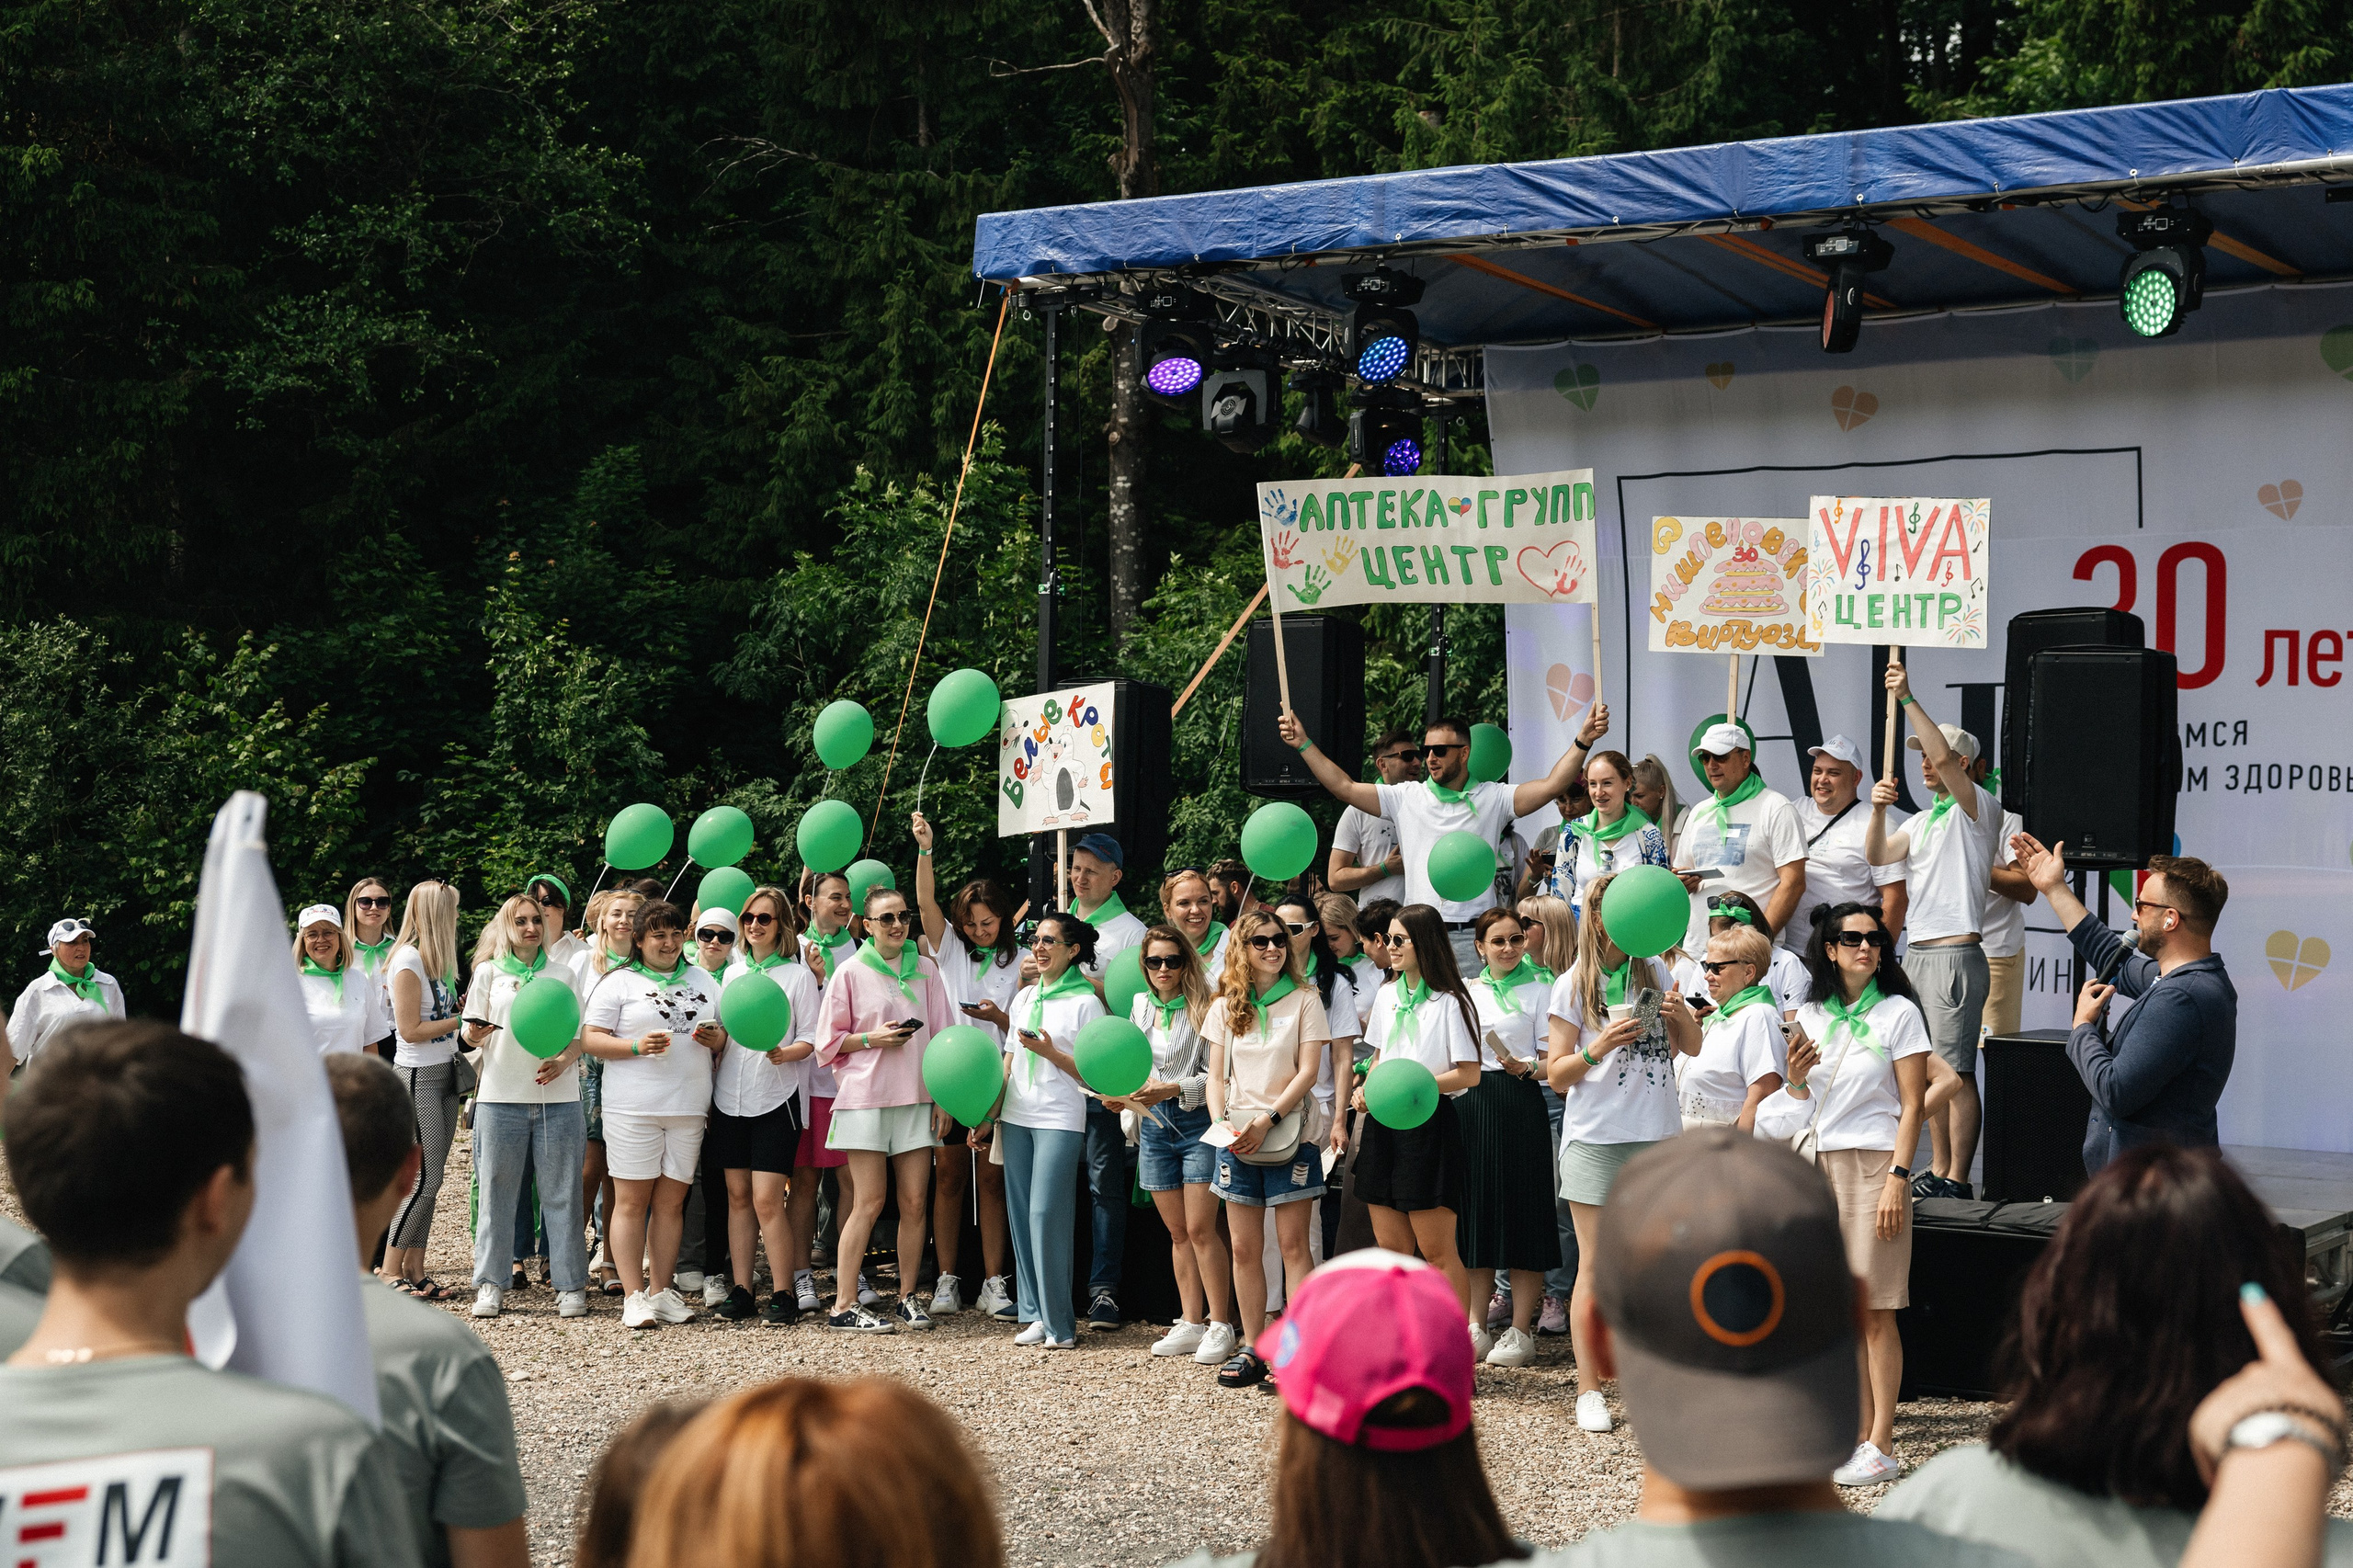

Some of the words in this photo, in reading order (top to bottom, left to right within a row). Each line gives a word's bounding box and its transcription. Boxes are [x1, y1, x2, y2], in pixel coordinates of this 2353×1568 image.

[1299, 489, 1449, 532] АПТЕКА
[1477, 482, 1595, 528] ГРУПП
[1732, 547, 1758, 562] 30
[1819, 504, 1972, 581] VIVA
[1361, 545, 1508, 589] ЦЕНТР
[1836, 593, 1961, 630] ЦЕНТР
[2256, 629, 2353, 687] ле
[2177, 720, 2248, 748] МСЯ
